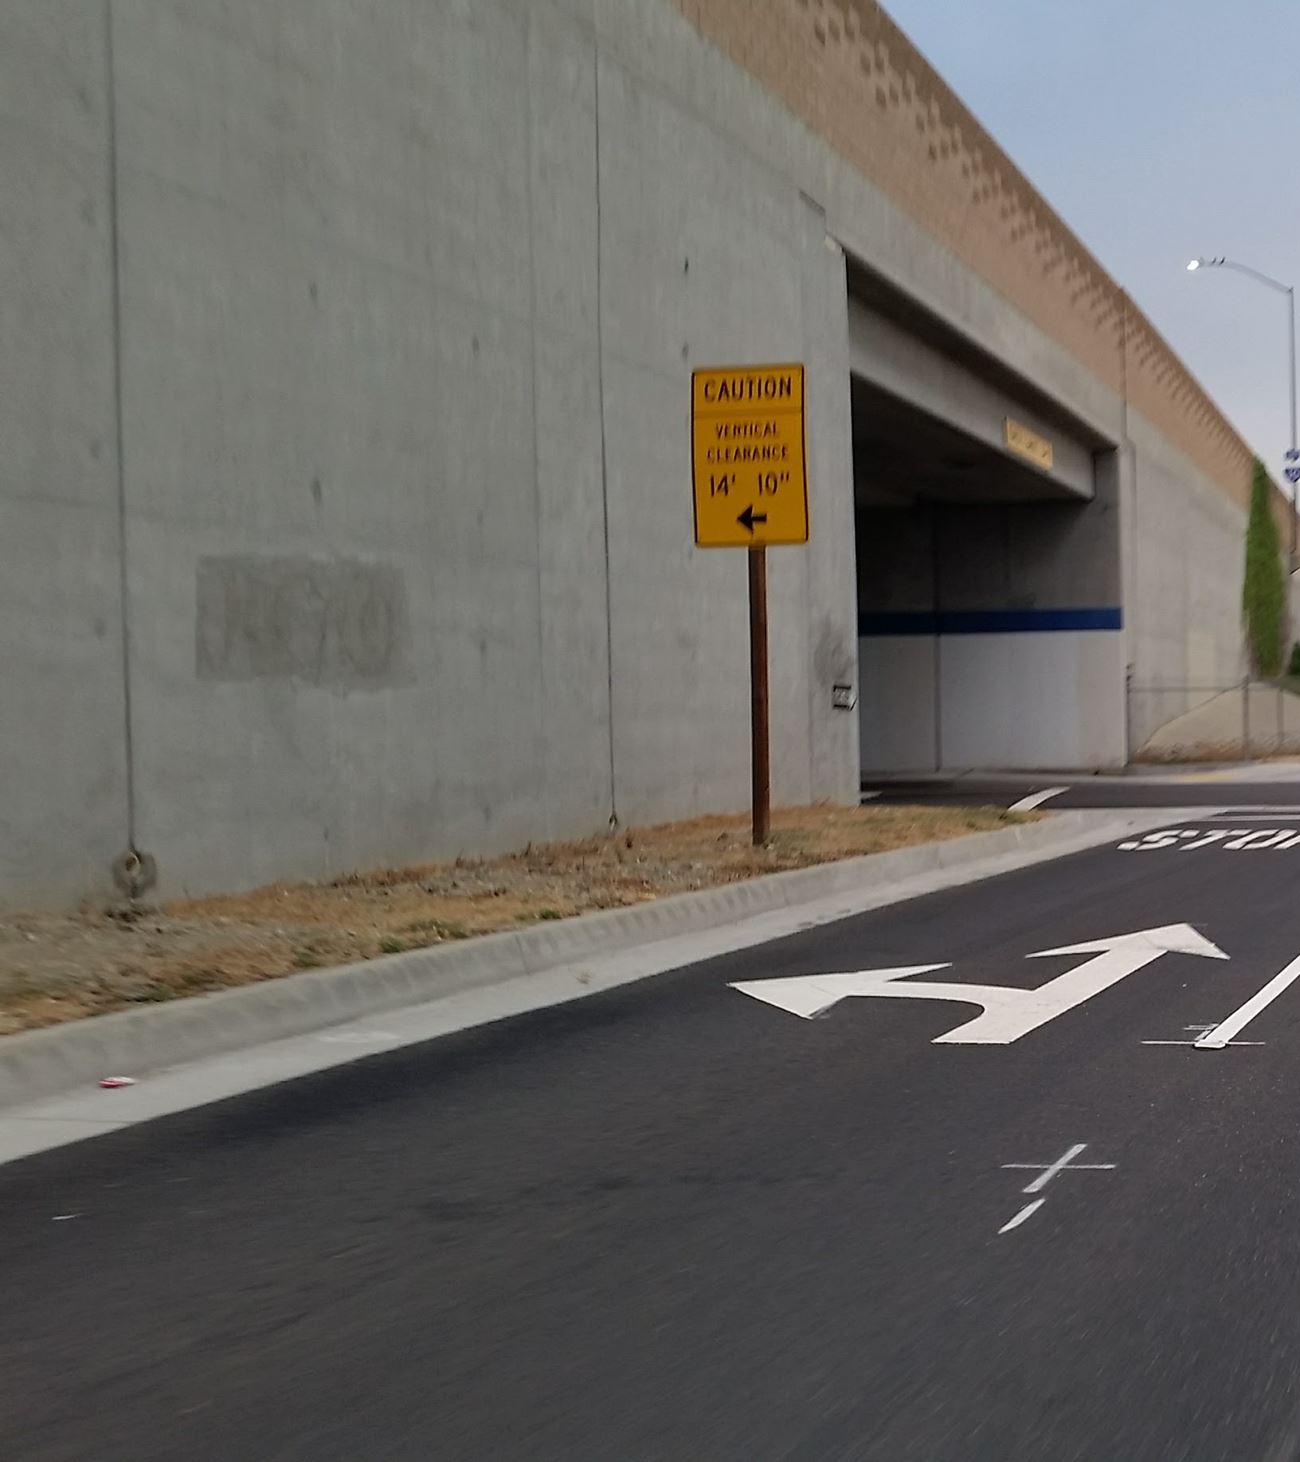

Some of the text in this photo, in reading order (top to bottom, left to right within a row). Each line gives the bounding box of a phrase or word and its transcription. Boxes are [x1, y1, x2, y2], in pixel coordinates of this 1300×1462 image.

[703, 375, 792, 402] CAUTION
[715, 420, 779, 440] VERTICAL
[706, 443, 788, 465] CLEARANCE
[709, 471, 790, 498] 14' 10"
